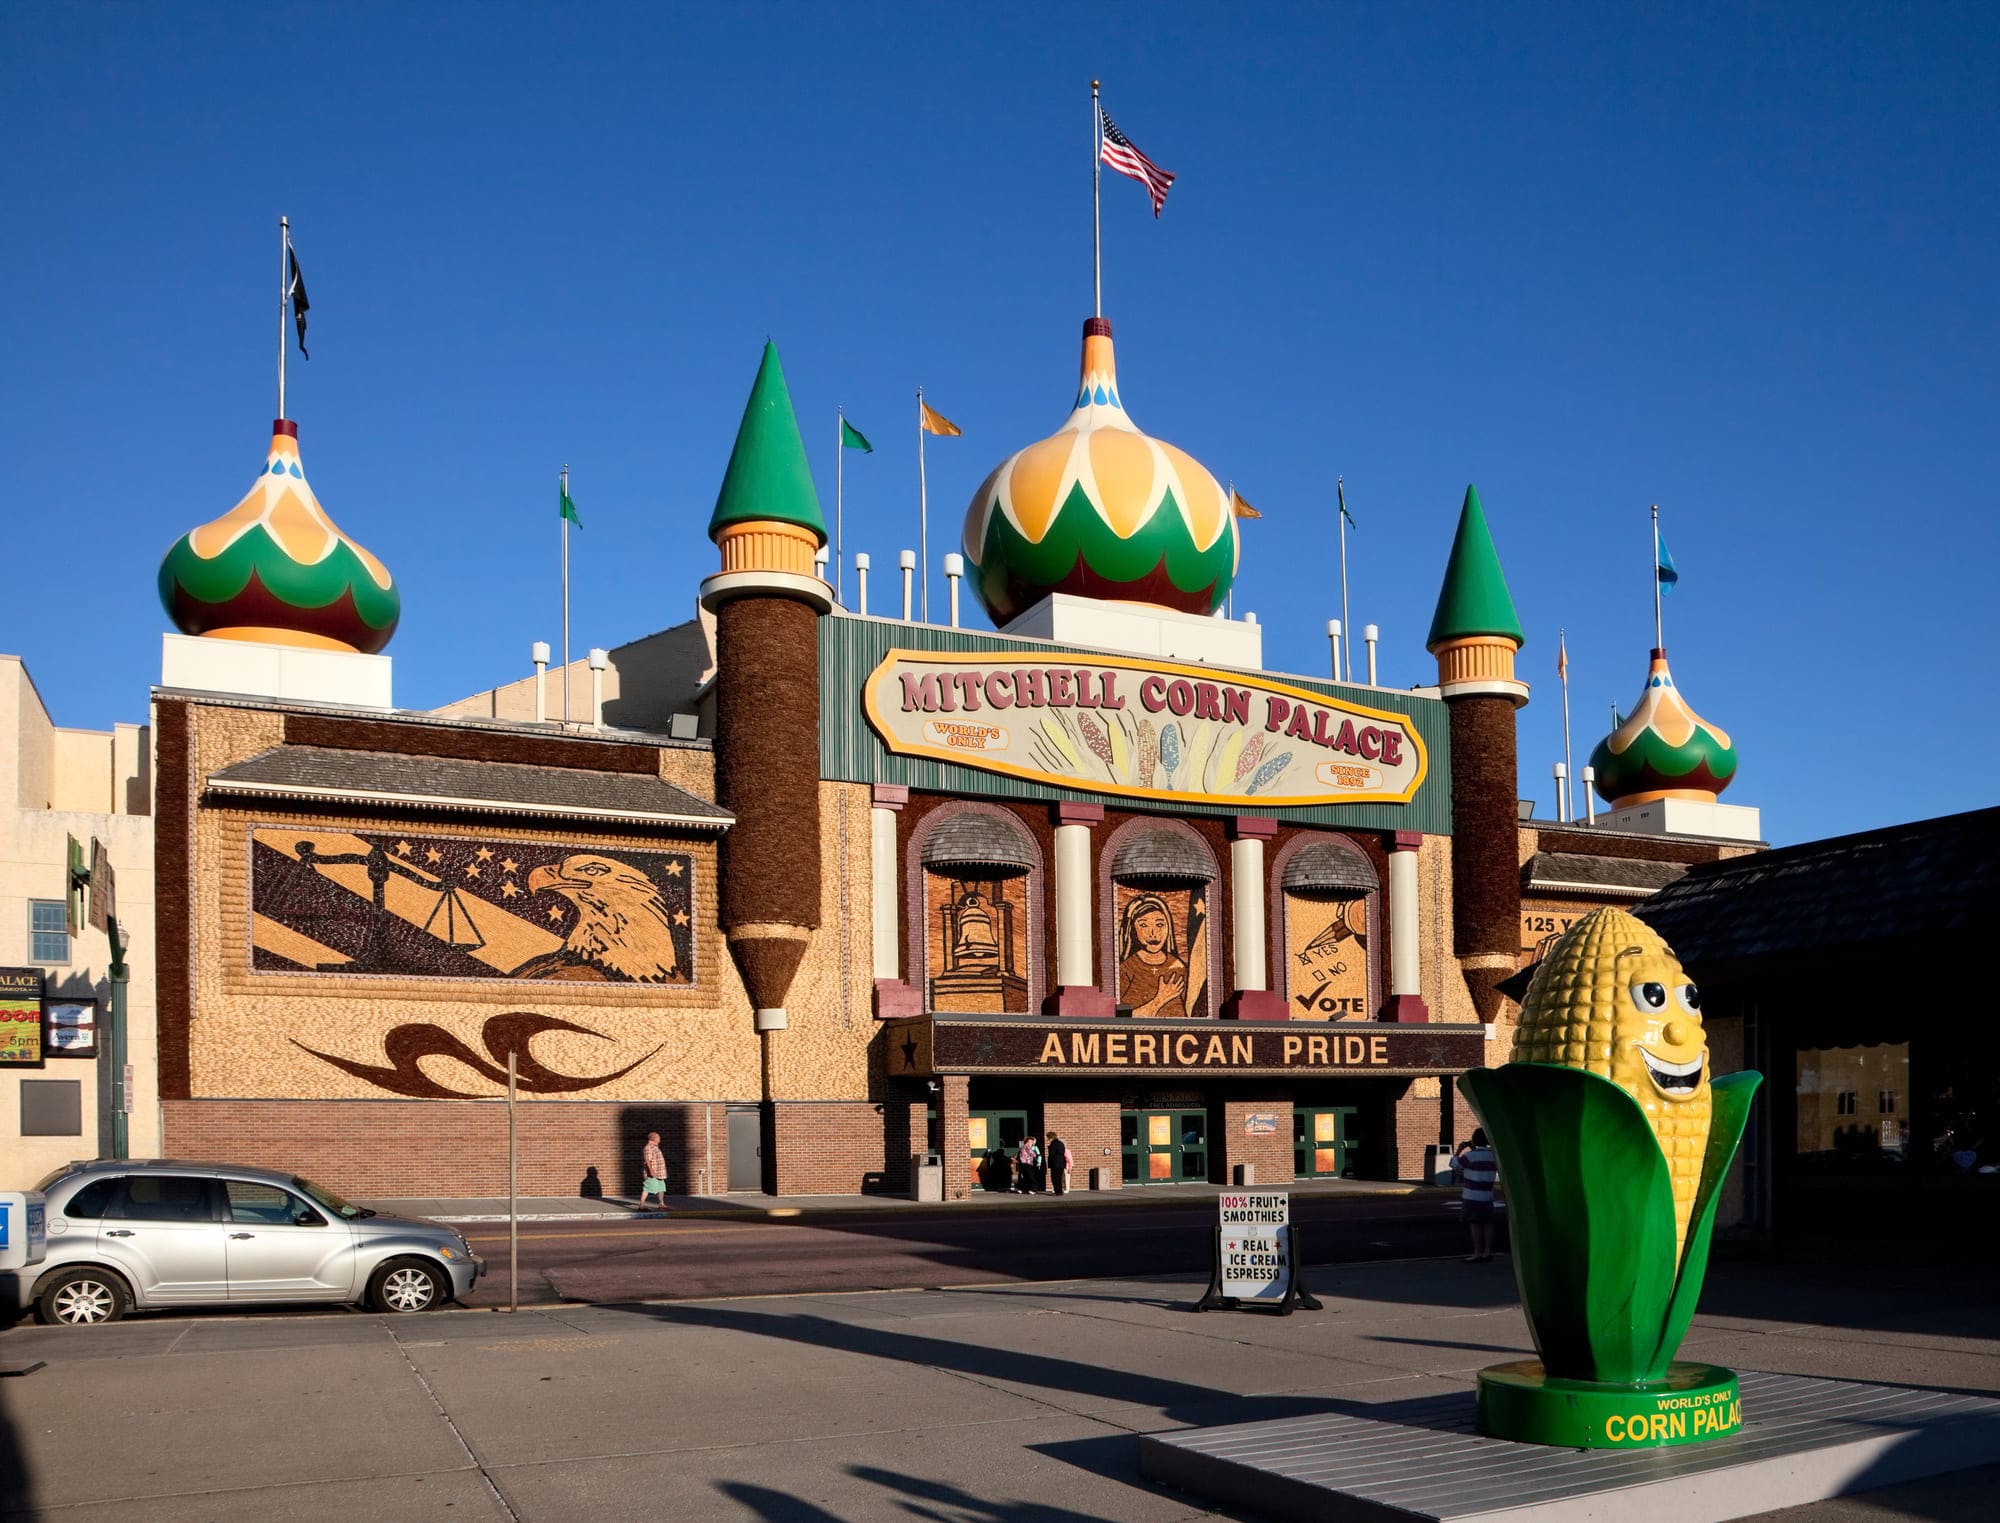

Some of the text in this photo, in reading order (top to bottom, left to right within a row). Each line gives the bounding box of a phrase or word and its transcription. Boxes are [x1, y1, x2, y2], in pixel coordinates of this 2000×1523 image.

[899, 669, 1404, 766] MITCHELL CORN PALACE
[933, 722, 1000, 739] WORLD'S
[947, 735, 986, 748] ONLY
[1330, 765, 1370, 778] SINCE
[1337, 775, 1364, 787] 1892
[1524, 916, 1555, 932] 125
[1312, 944, 1338, 958] YES
[1328, 961, 1347, 976] NO
[9, 1036, 38, 1046] 5pm
[1039, 1032, 1388, 1065] AMERICAN PRIDE
[1221, 1196, 1279, 1208] 100% FRUIT
[1223, 1211, 1284, 1222] SMOOTHIES
[1243, 1240, 1269, 1251] REAL
[1230, 1254, 1286, 1266] ICE CREAM
[1226, 1268, 1280, 1280] ESPRESSO
[1657, 1389, 1732, 1410] WORLD'S ONLY
[1605, 1411, 1686, 1442] CORN
